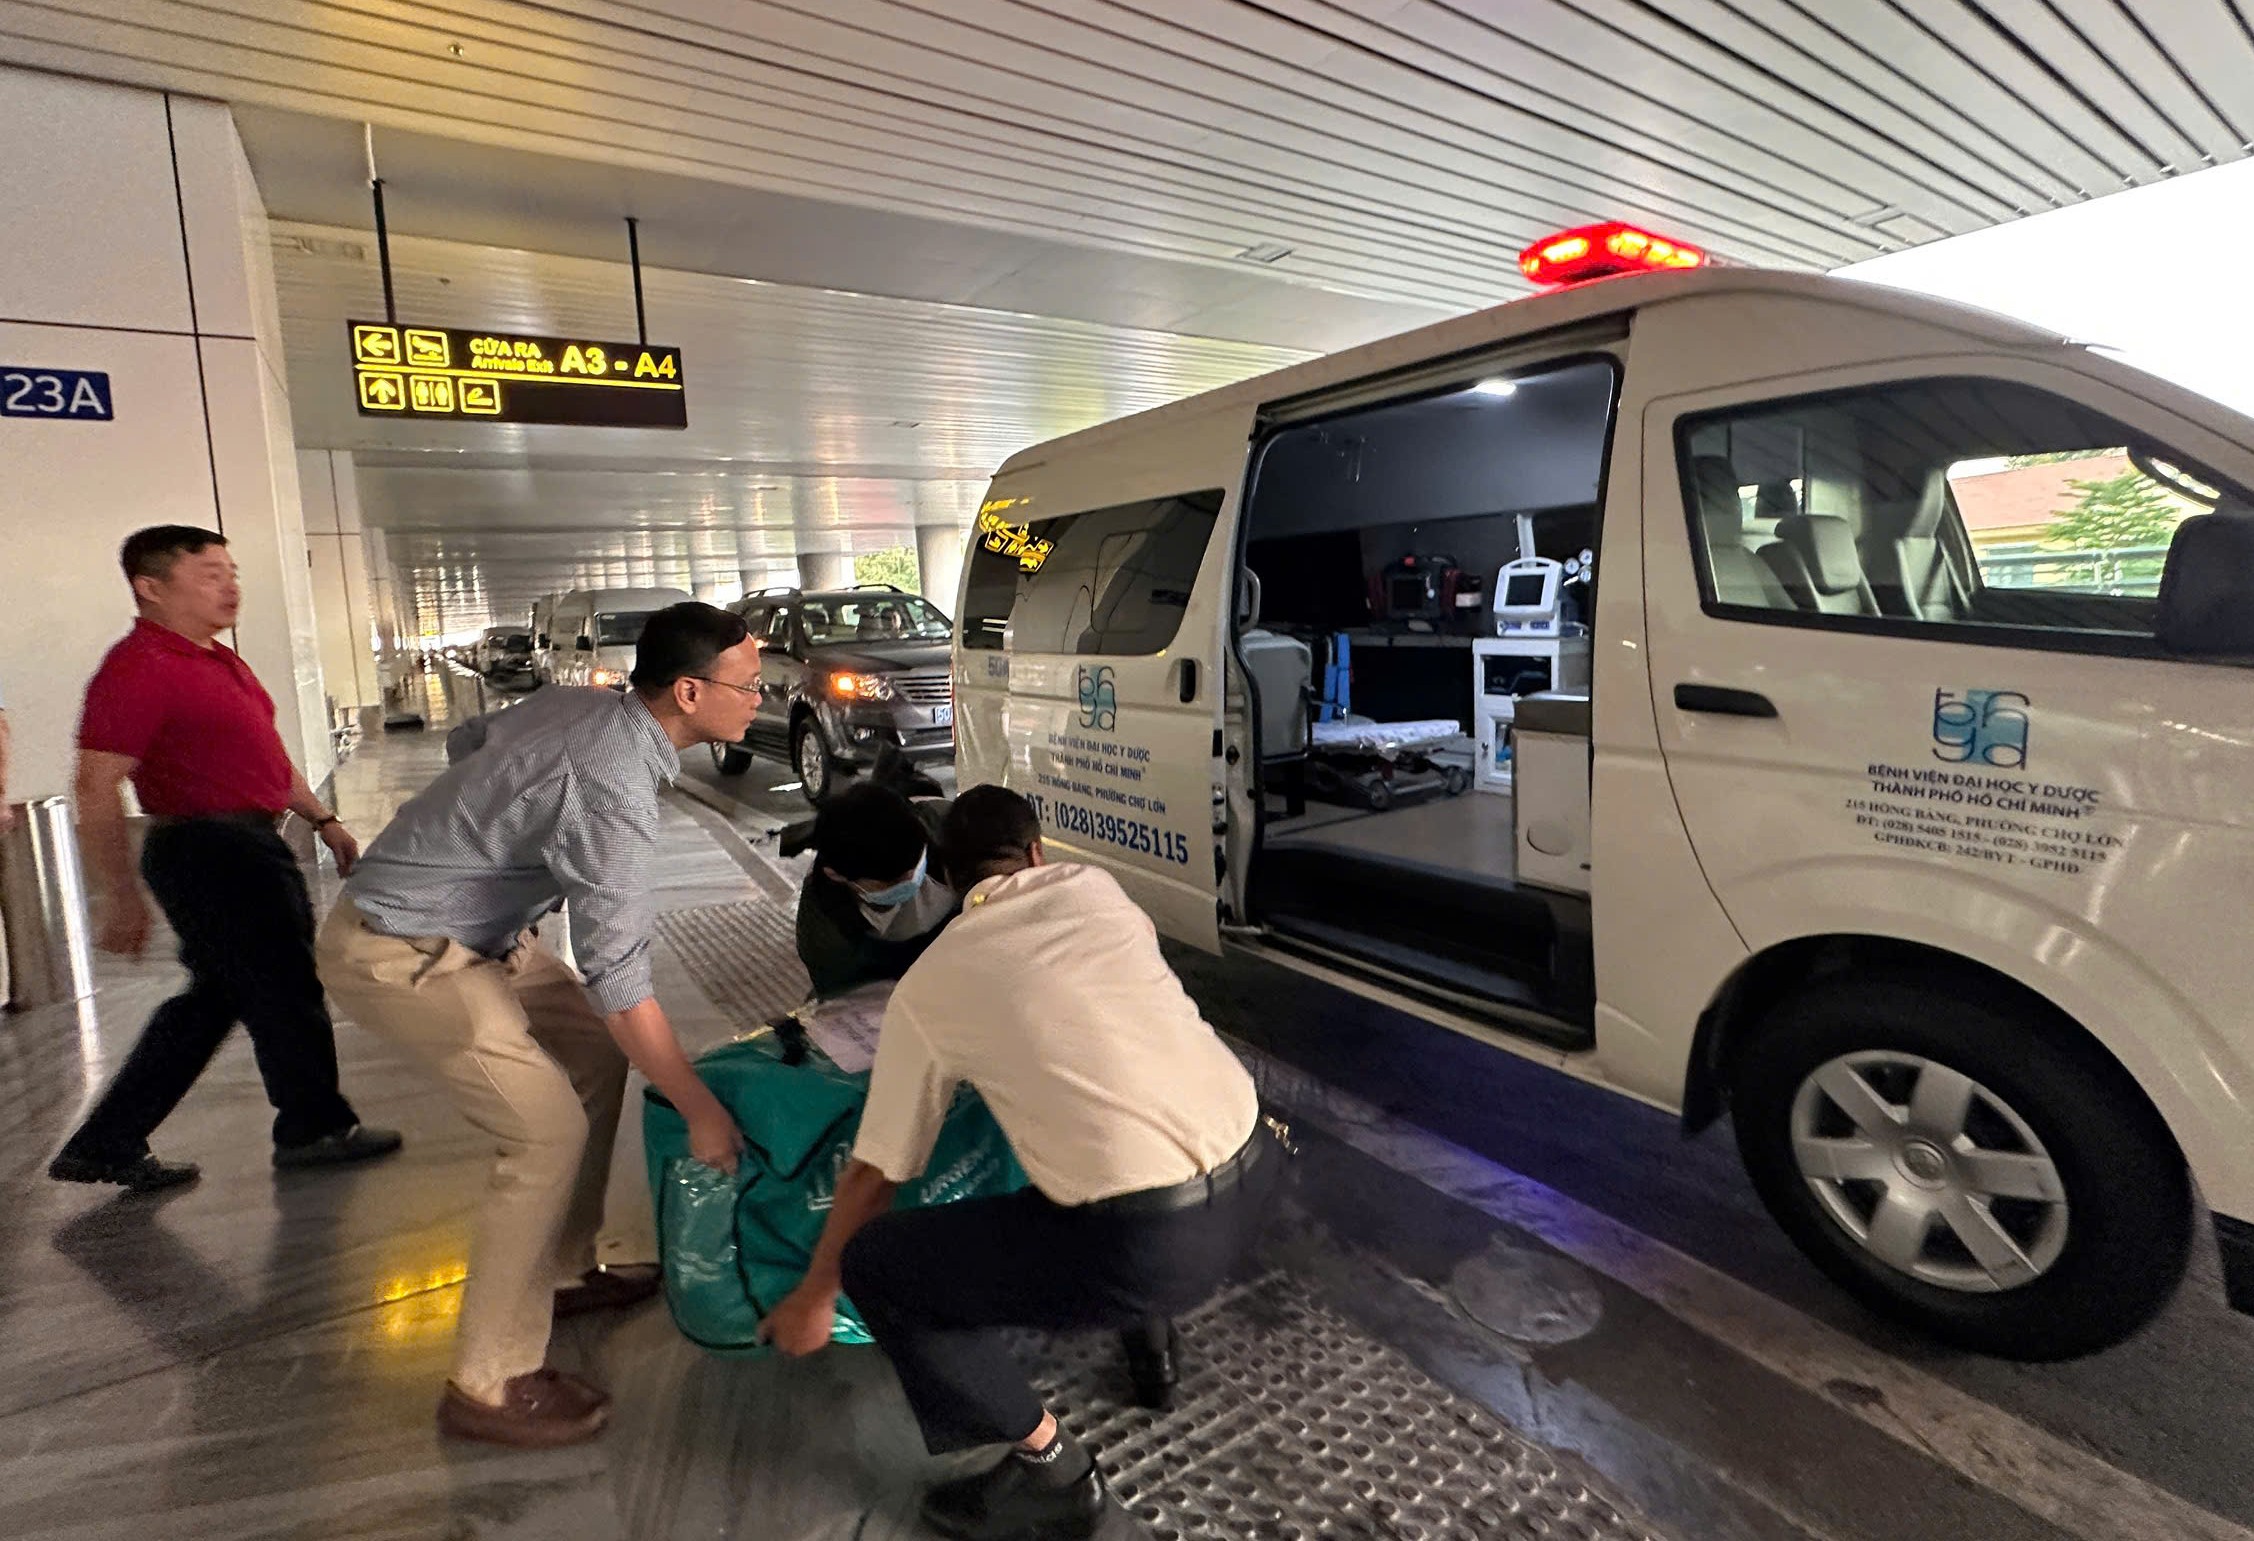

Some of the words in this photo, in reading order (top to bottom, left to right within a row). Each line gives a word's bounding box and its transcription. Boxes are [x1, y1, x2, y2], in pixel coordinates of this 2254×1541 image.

[514, 341, 542, 359] RA
[560, 345, 607, 376] A3
[634, 352, 676, 379] A4
[4, 373, 105, 414] 23A
[1102, 743, 1118, 757] HỌC
[1119, 746, 1126, 757] Y
[1120, 765, 1142, 781] MINH
[1868, 764, 1908, 779] BỆNH
[1912, 769, 1949, 785] VIỆN
[1986, 778, 2024, 794] HỌC
[2029, 782, 2038, 795] Y
[2043, 785, 2100, 804] DƯỢC
[1872, 780, 1925, 798] THÀNH
[2030, 801, 2080, 819] MINH
